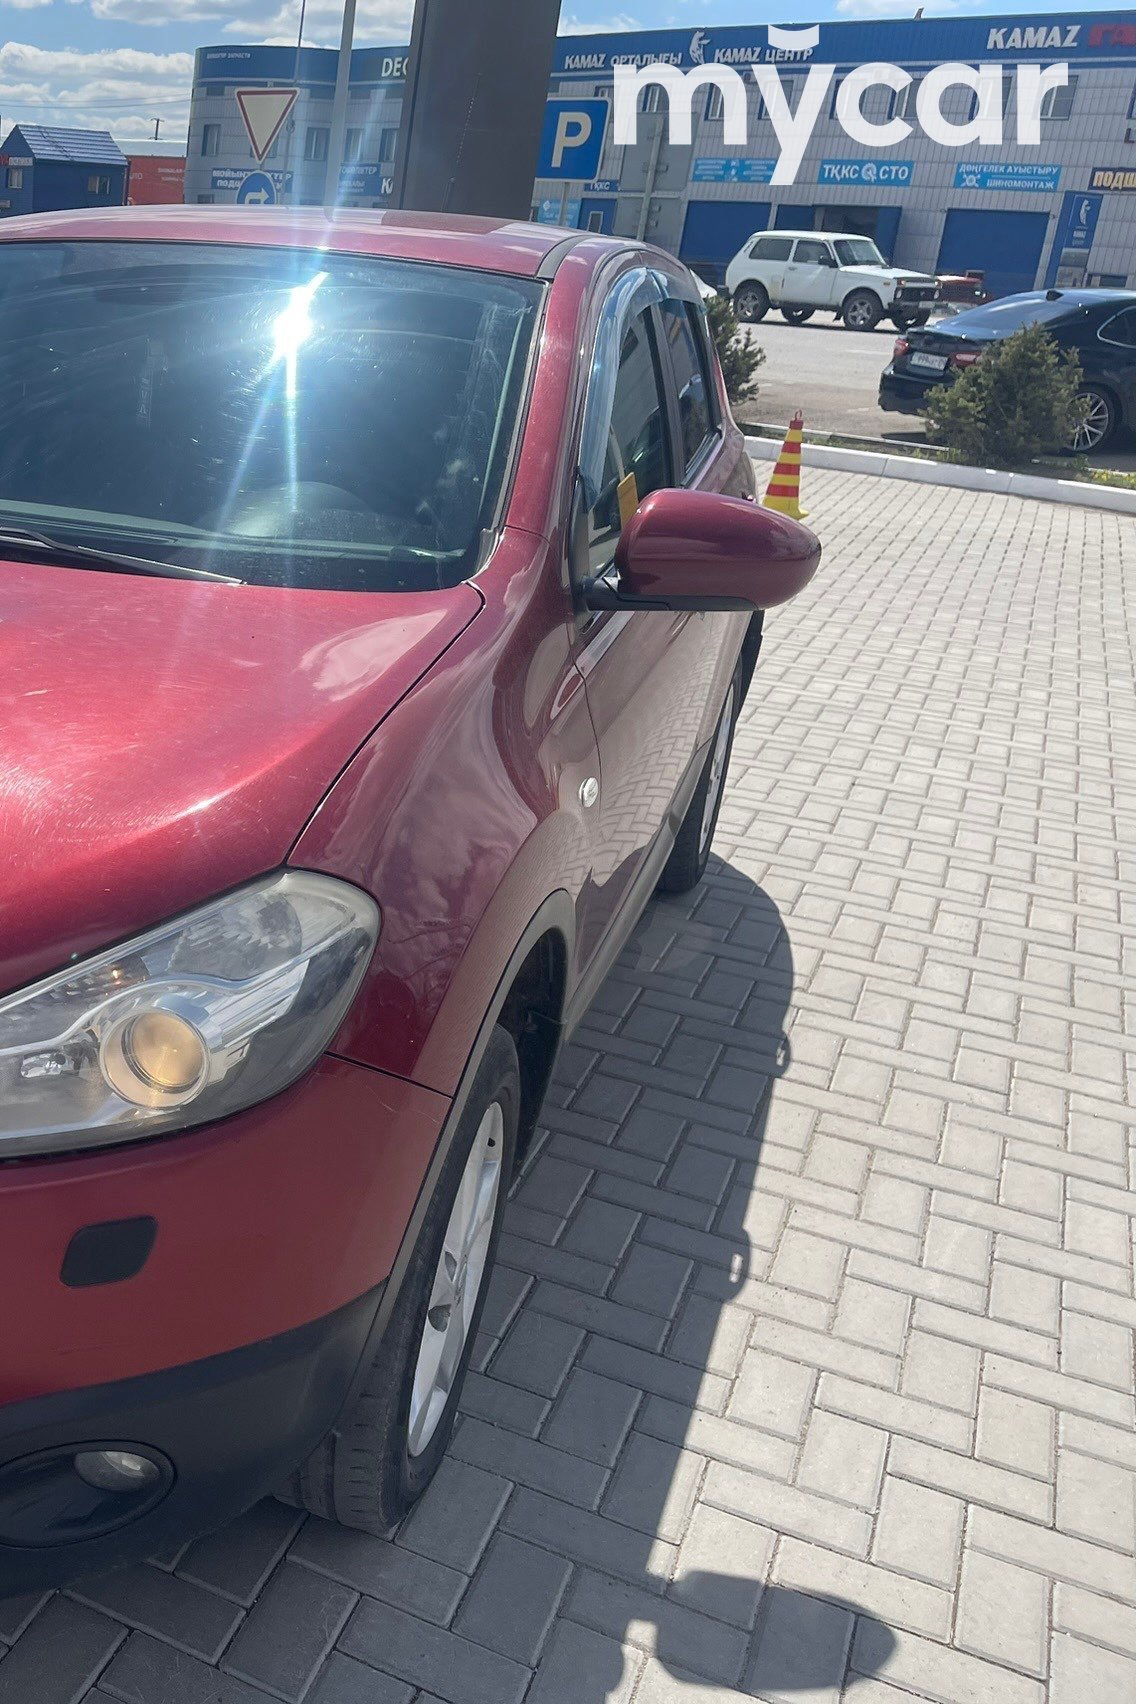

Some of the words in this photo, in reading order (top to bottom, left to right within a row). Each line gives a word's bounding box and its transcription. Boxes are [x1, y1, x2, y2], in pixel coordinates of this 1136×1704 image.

[987, 24, 1081, 50] KAMAZ
[564, 53, 606, 70] KAMAZ
[714, 47, 762, 64] KAMAZ
[765, 48, 814, 63] ЦЕНТР
[551, 111, 592, 168] P
[879, 165, 909, 180] СТО
[1006, 165, 1060, 175] АУЫСТЫРУ
[986, 179, 1055, 190] ШИНОМОНТАЖ
